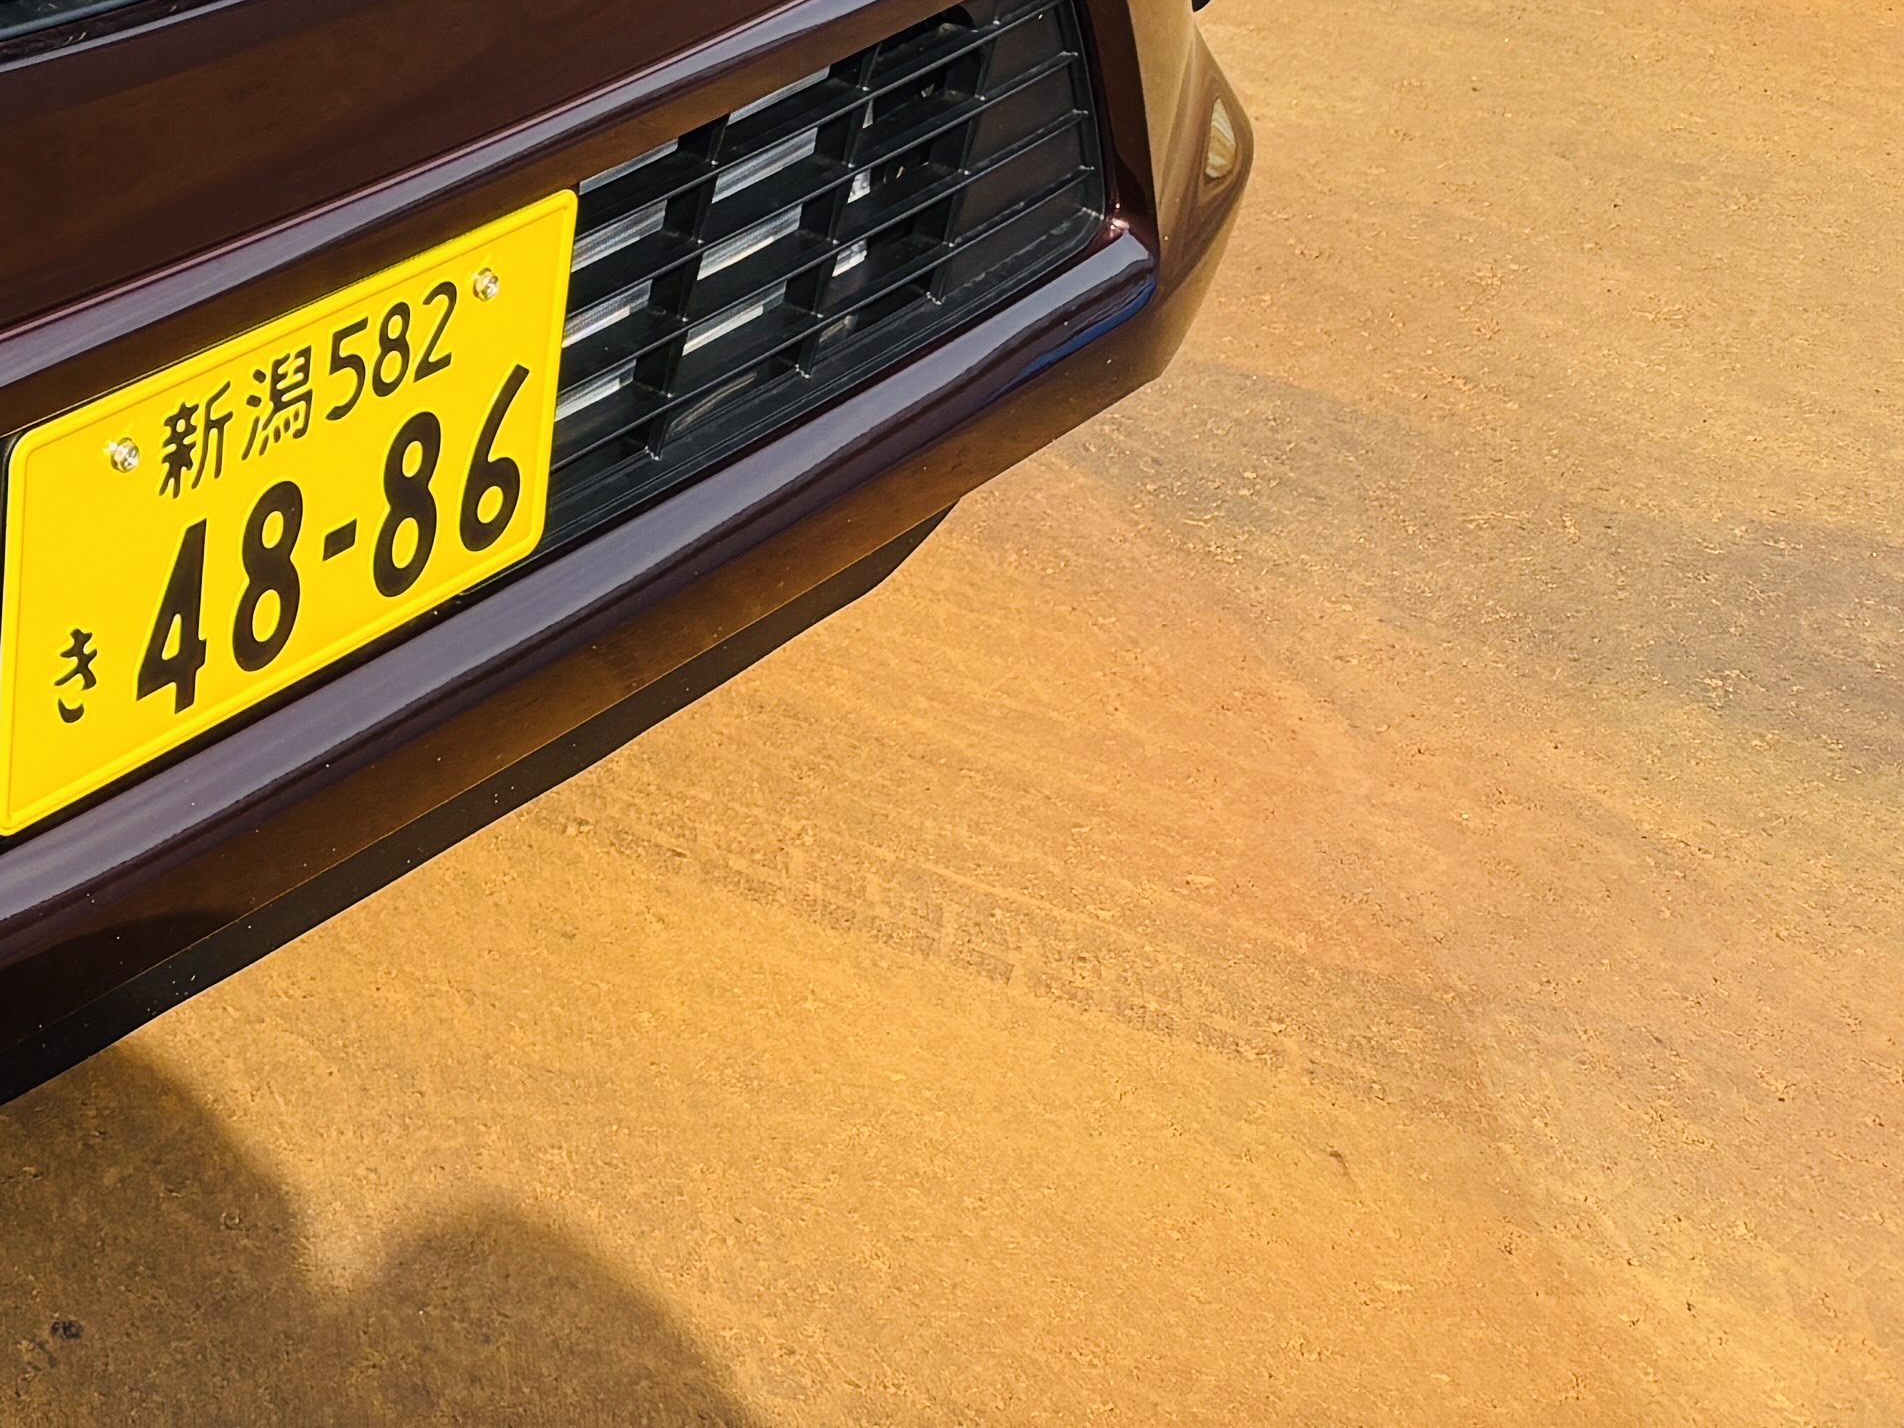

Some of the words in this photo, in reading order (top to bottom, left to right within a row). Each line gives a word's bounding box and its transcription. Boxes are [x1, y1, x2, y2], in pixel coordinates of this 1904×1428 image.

[158, 279, 459, 500] 新潟582
[53, 626, 98, 724] き
[135, 362, 531, 716] 48-86
